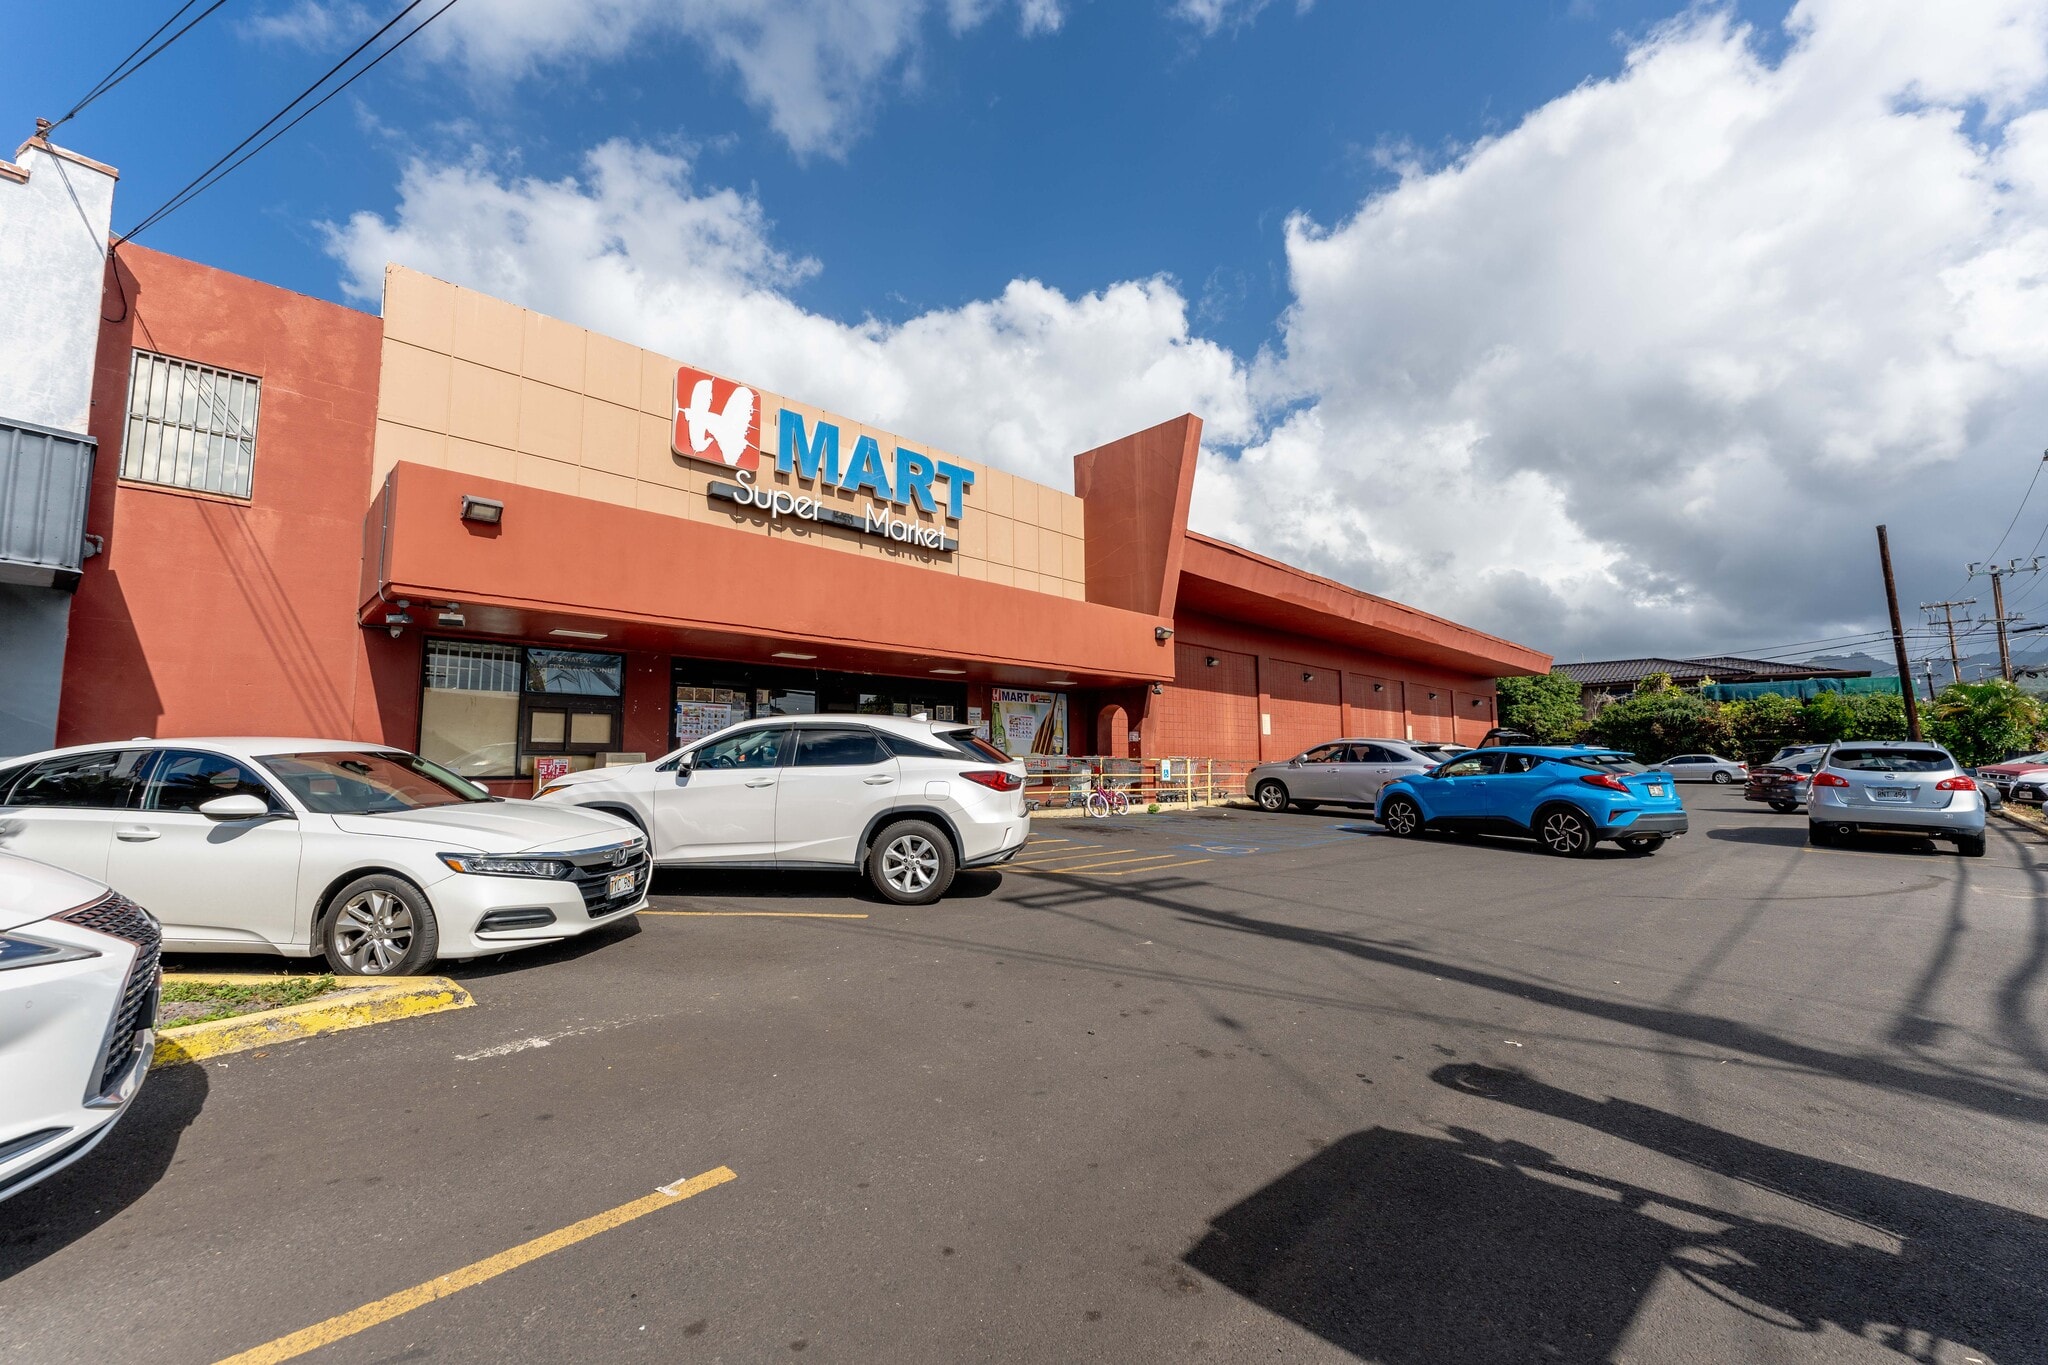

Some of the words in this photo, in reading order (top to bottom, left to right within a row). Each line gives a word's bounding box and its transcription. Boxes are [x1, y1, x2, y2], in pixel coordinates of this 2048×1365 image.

[775, 407, 975, 520] MART
[732, 470, 823, 522] Super
[864, 502, 947, 551] Market
[1001, 690, 1029, 702] MART
